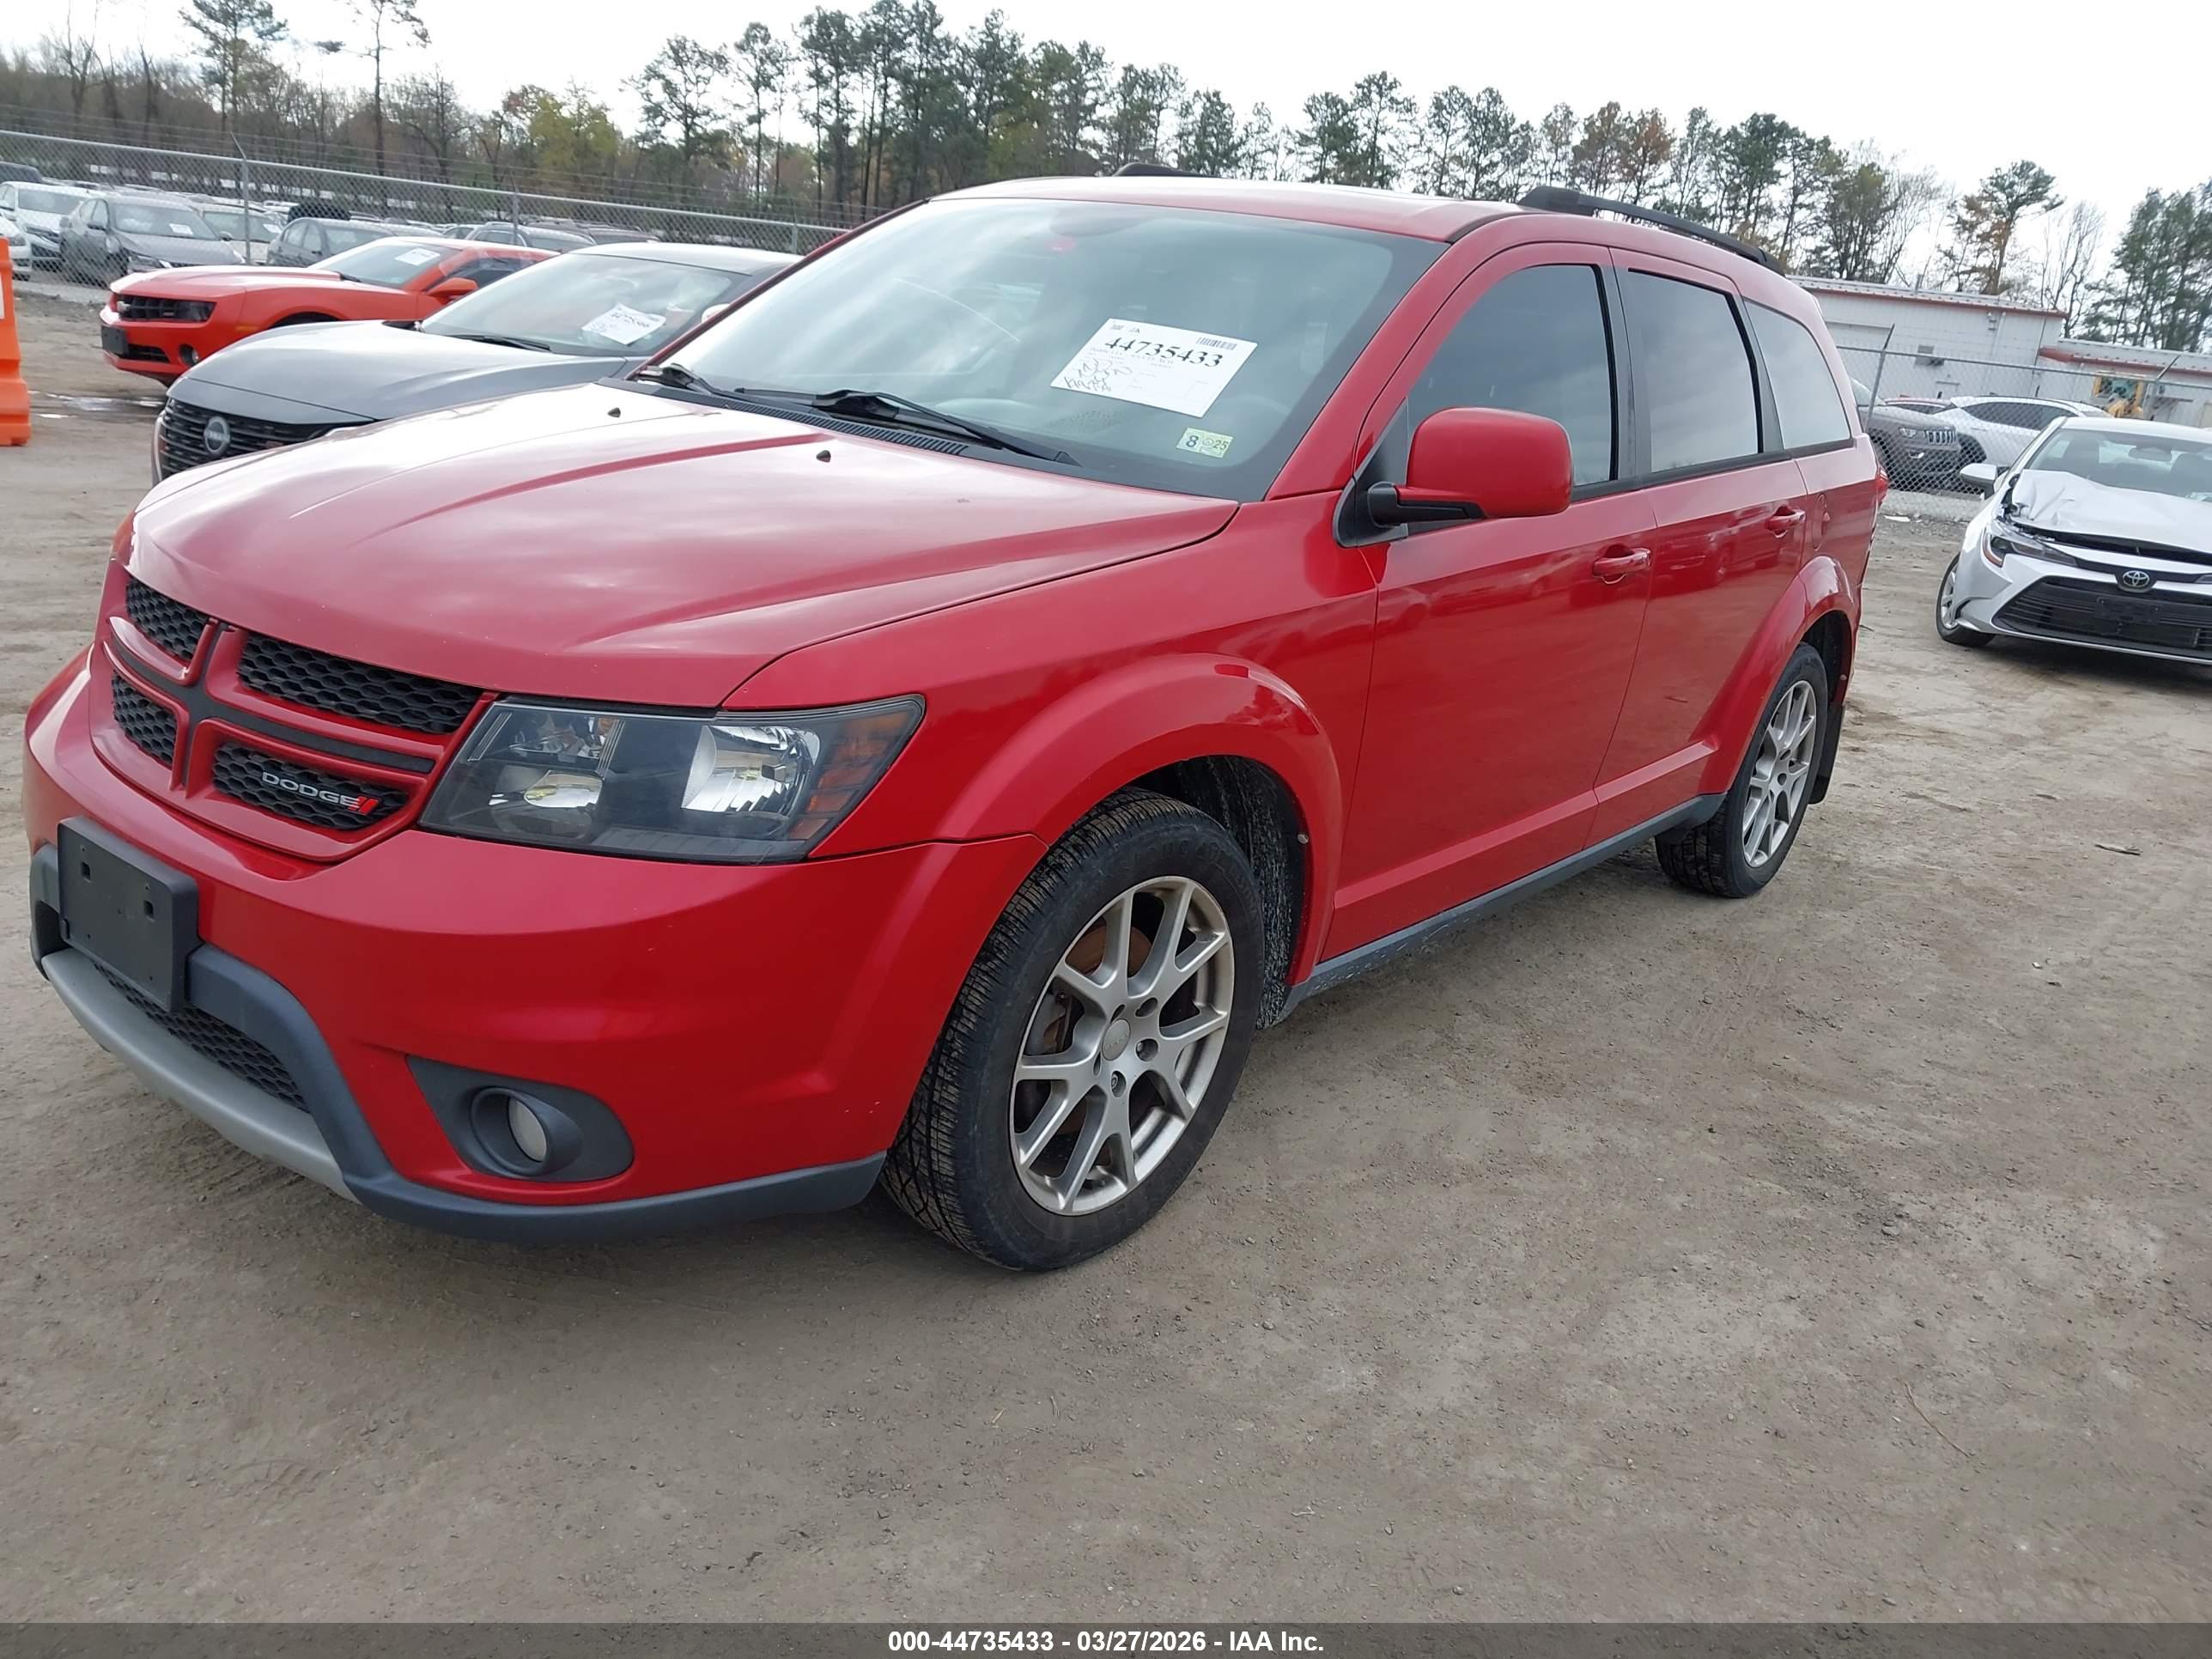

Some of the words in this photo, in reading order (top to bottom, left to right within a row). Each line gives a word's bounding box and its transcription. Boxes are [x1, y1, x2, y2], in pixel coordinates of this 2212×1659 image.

[1105, 337, 1224, 368] 44735433
[1185, 435, 1199, 447] 8
[1212, 440, 1229, 450] 25
[262, 771, 360, 809] DODGE
